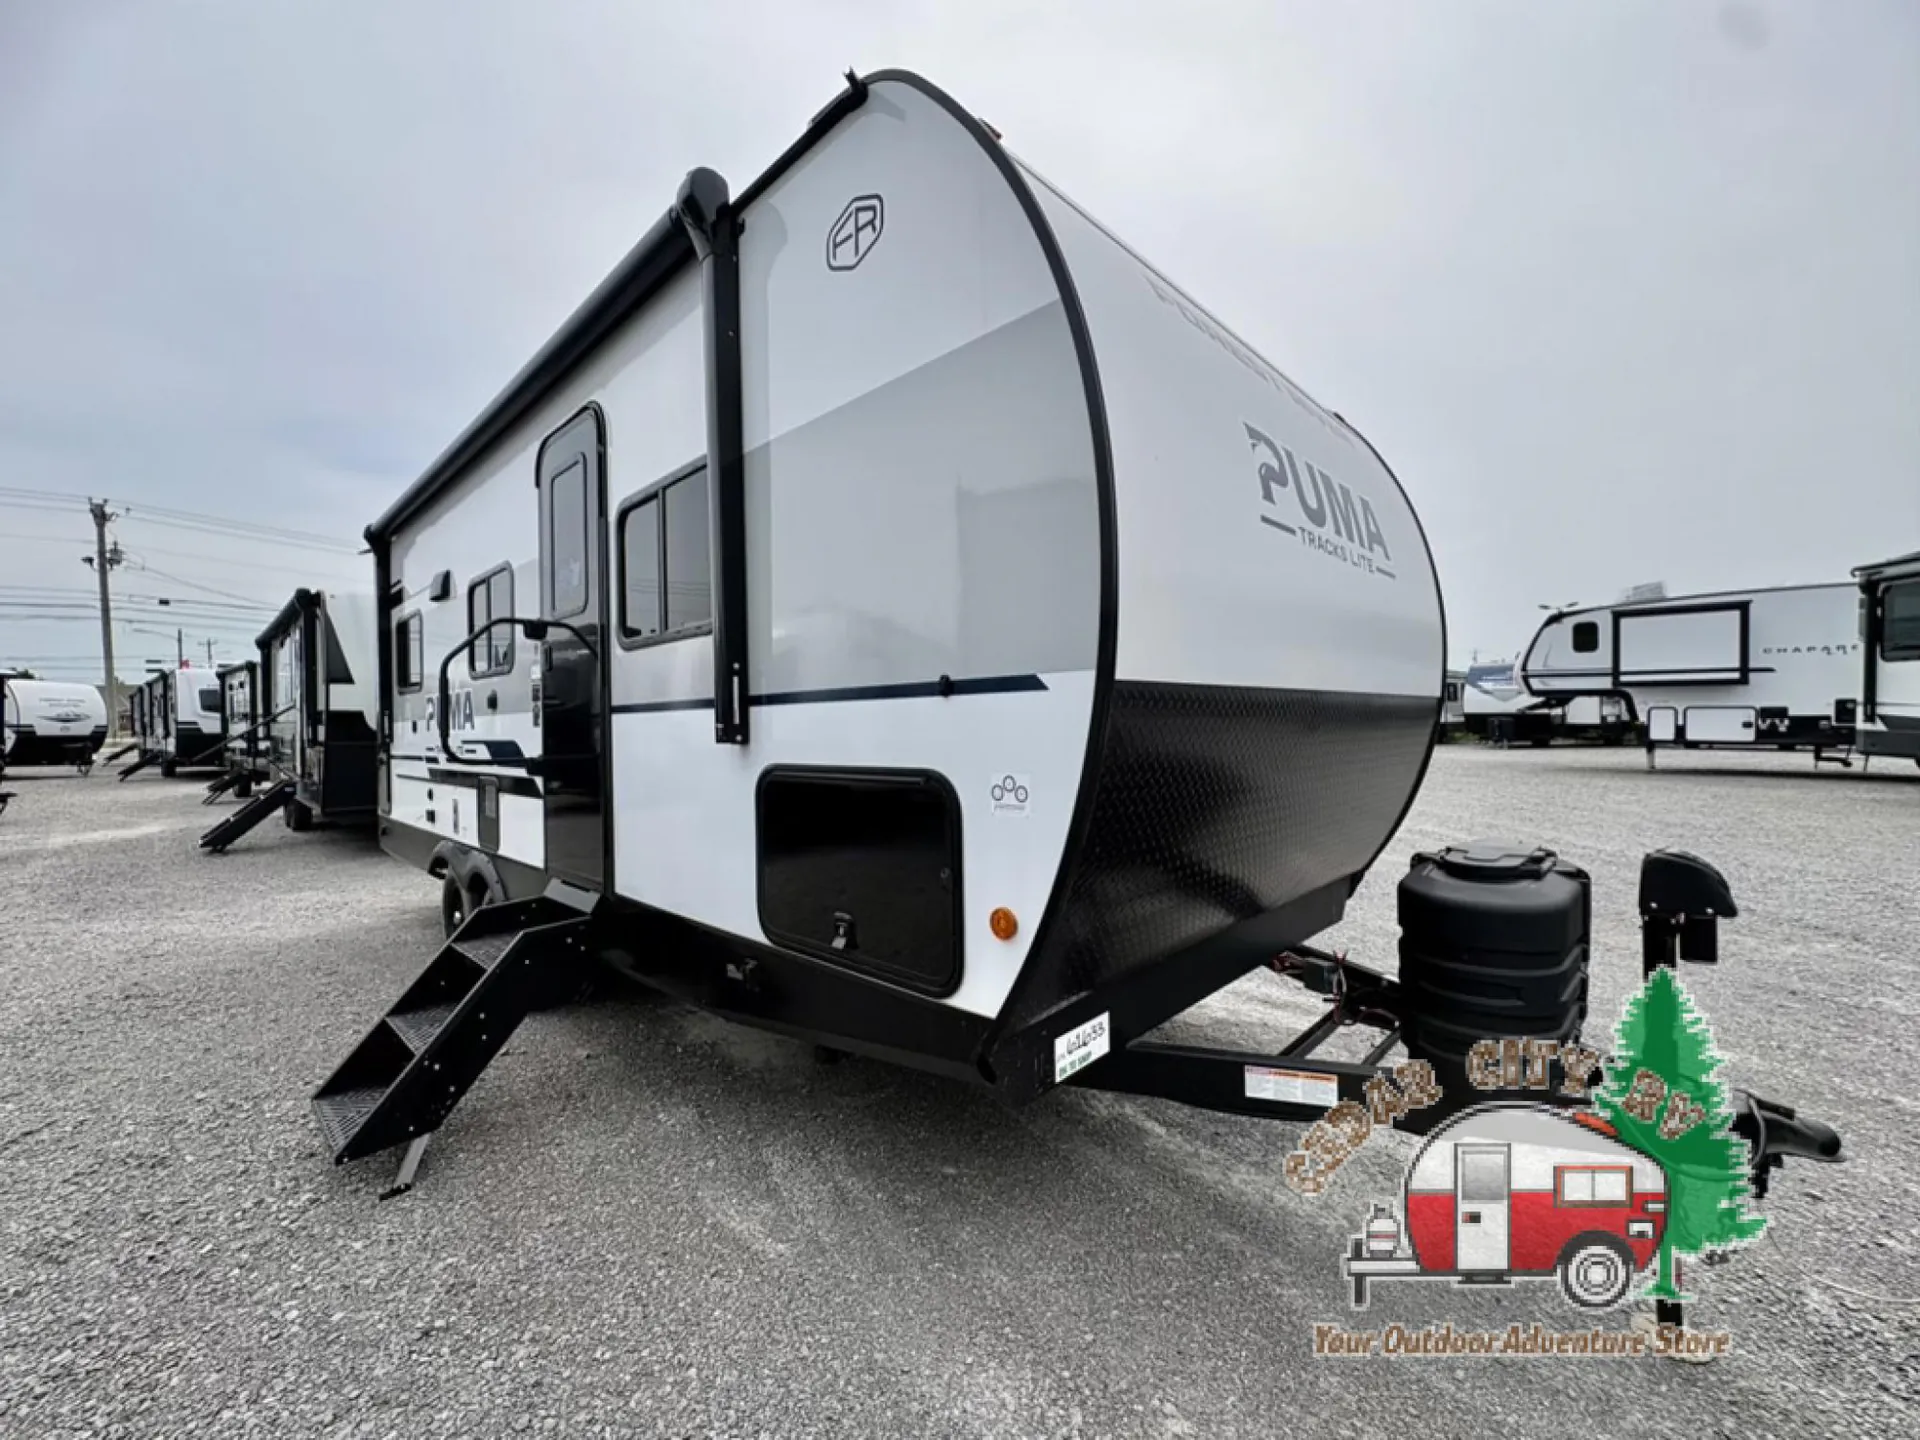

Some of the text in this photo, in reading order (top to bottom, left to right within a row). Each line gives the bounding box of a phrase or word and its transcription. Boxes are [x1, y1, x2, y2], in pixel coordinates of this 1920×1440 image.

[1242, 420, 1391, 562] PUMA
[1298, 525, 1375, 574] TRACKS LITE
